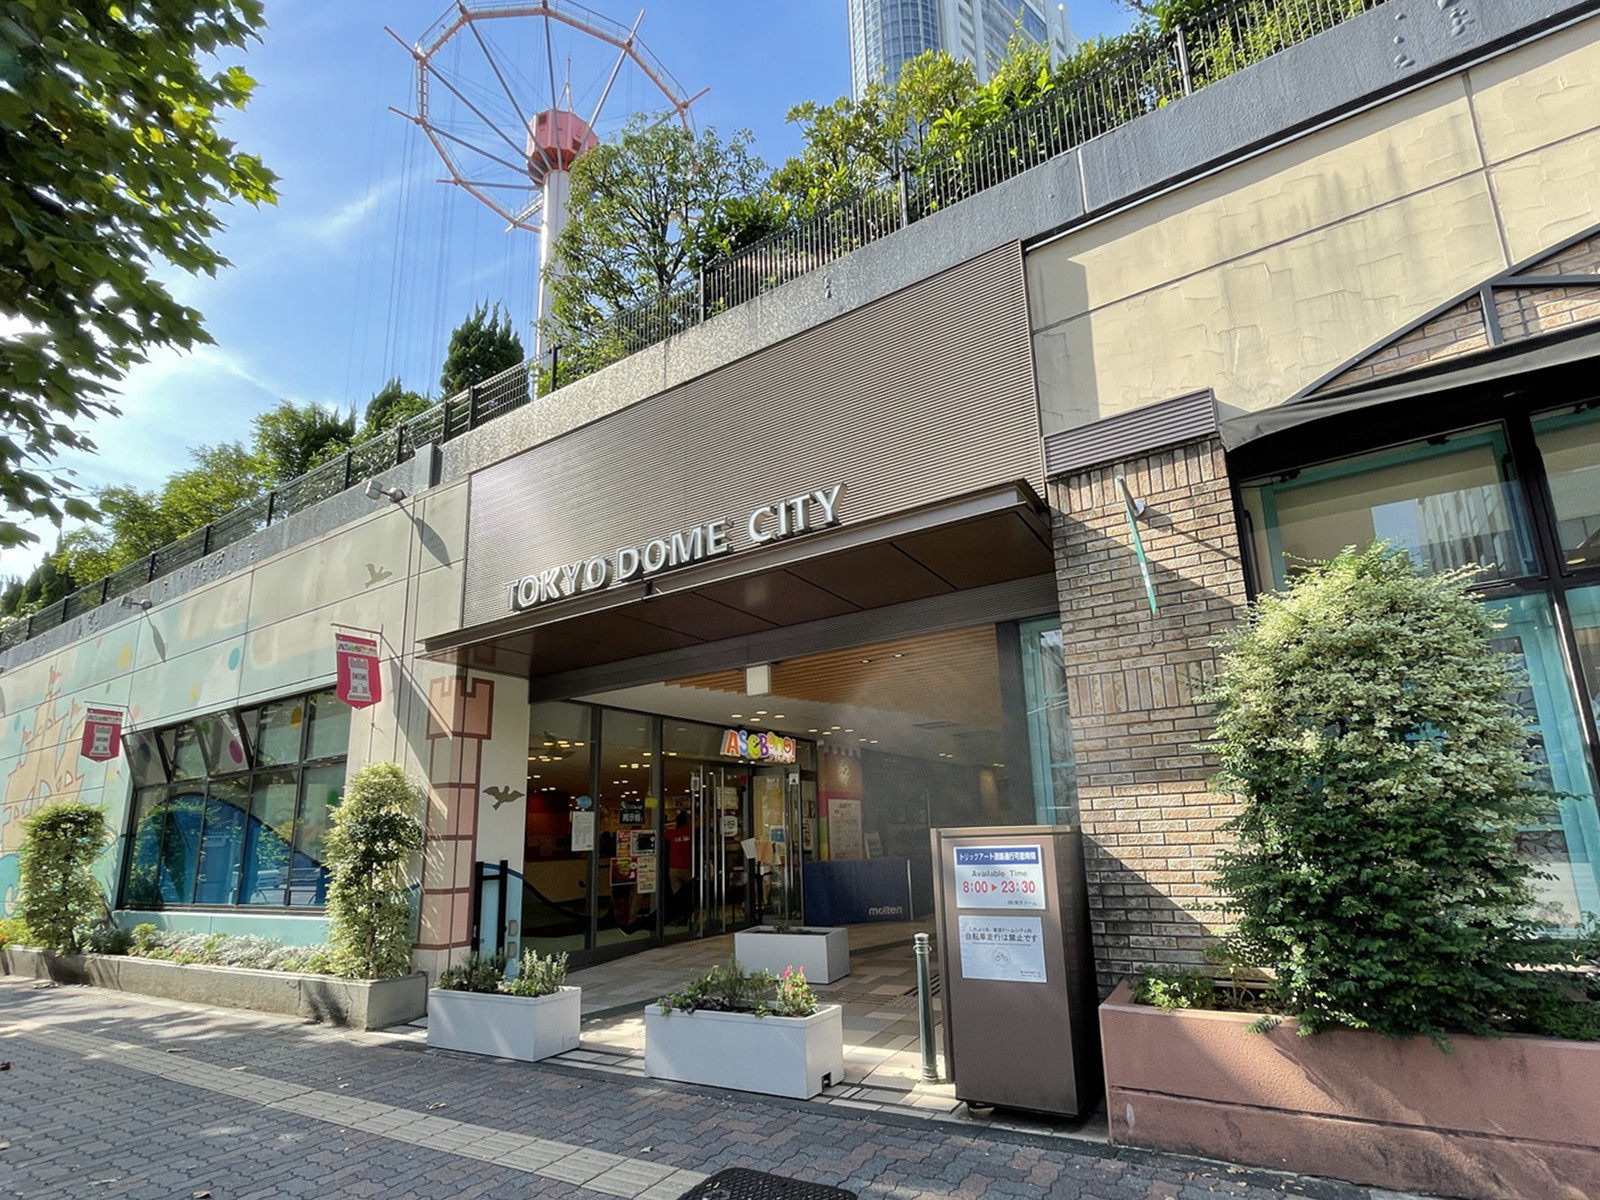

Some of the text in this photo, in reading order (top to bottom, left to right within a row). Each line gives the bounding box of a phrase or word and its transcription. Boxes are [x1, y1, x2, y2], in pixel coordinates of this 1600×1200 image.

[504, 481, 848, 611] TOKYO DOME CITY
[972, 870, 1029, 878] Available Time
[962, 880, 1036, 893] 8:00 23:30
[868, 906, 903, 916] molten
[965, 932, 1038, 942] 自転車走行は禁止です
